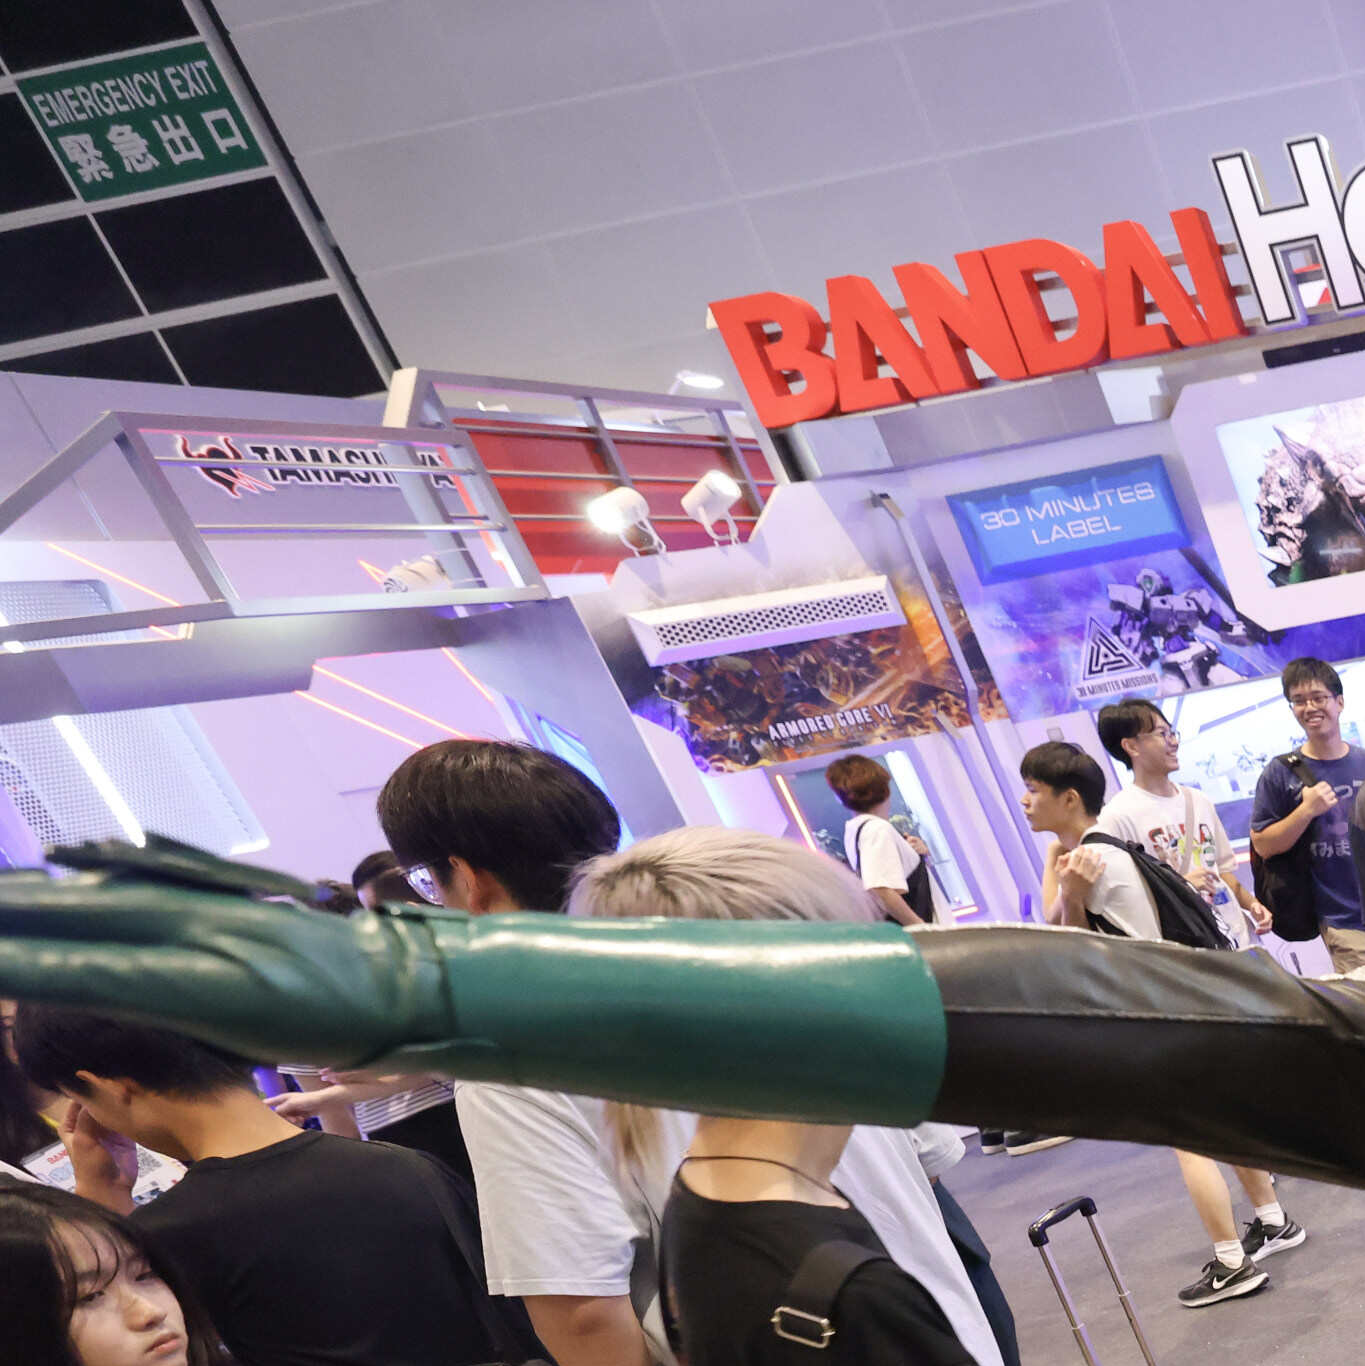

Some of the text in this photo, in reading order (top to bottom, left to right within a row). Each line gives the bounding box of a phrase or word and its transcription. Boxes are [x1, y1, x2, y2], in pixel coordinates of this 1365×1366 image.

[32, 60, 218, 127] EMERGENCY EXIT
[57, 107, 249, 184] 緊急出口
[708, 207, 1249, 429] BANDAI
[249, 446, 399, 488] TAMASH
[980, 481, 1156, 531] 30 MINUTES
[1031, 514, 1122, 546] LABEL
[768, 713, 835, 741] ARMORED
[836, 706, 873, 728] CORE
